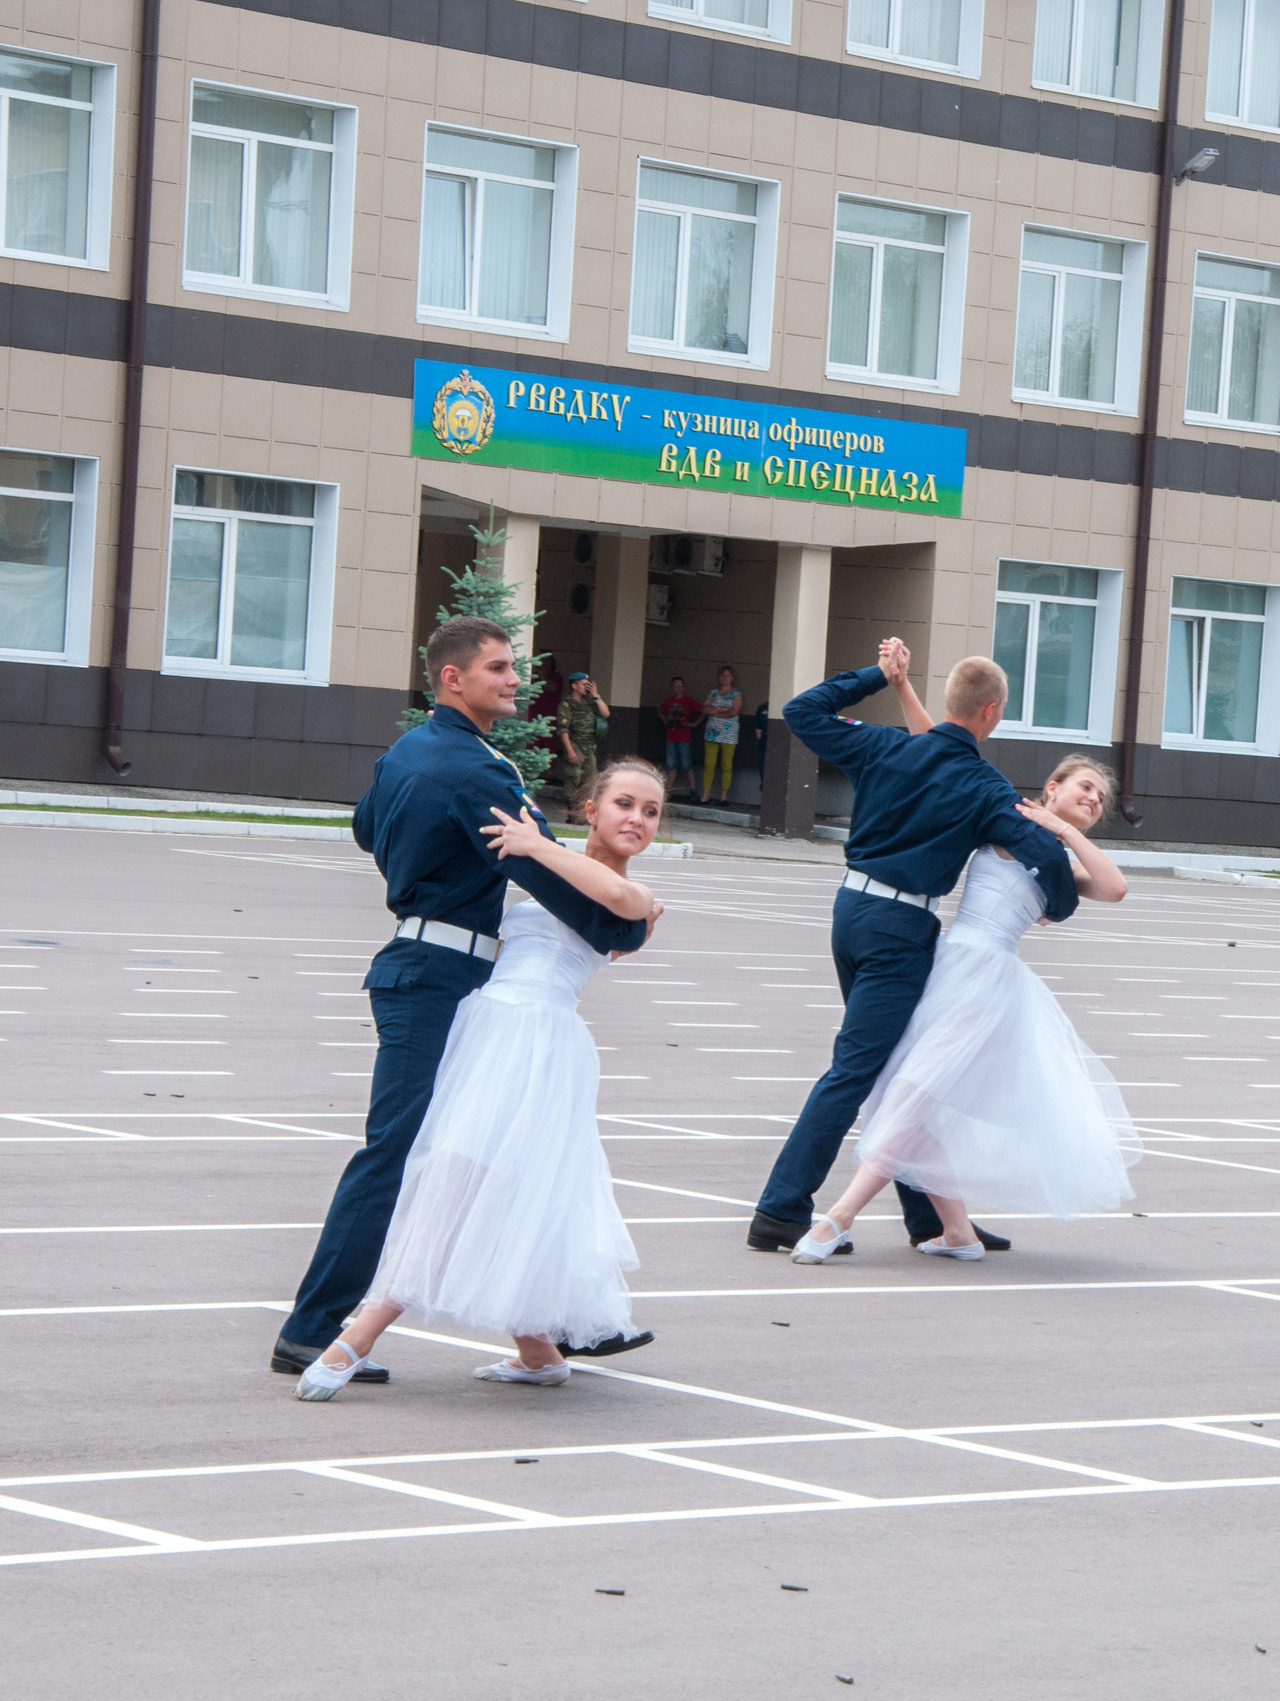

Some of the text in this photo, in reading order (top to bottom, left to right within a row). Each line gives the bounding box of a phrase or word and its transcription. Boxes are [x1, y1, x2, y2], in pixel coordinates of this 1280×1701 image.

[505, 380, 631, 431] РВВДКУ
[662, 409, 760, 440] кузница
[768, 417, 884, 457] офицеров
[657, 443, 938, 503] ВДВ и СПЕЦНАЗА
